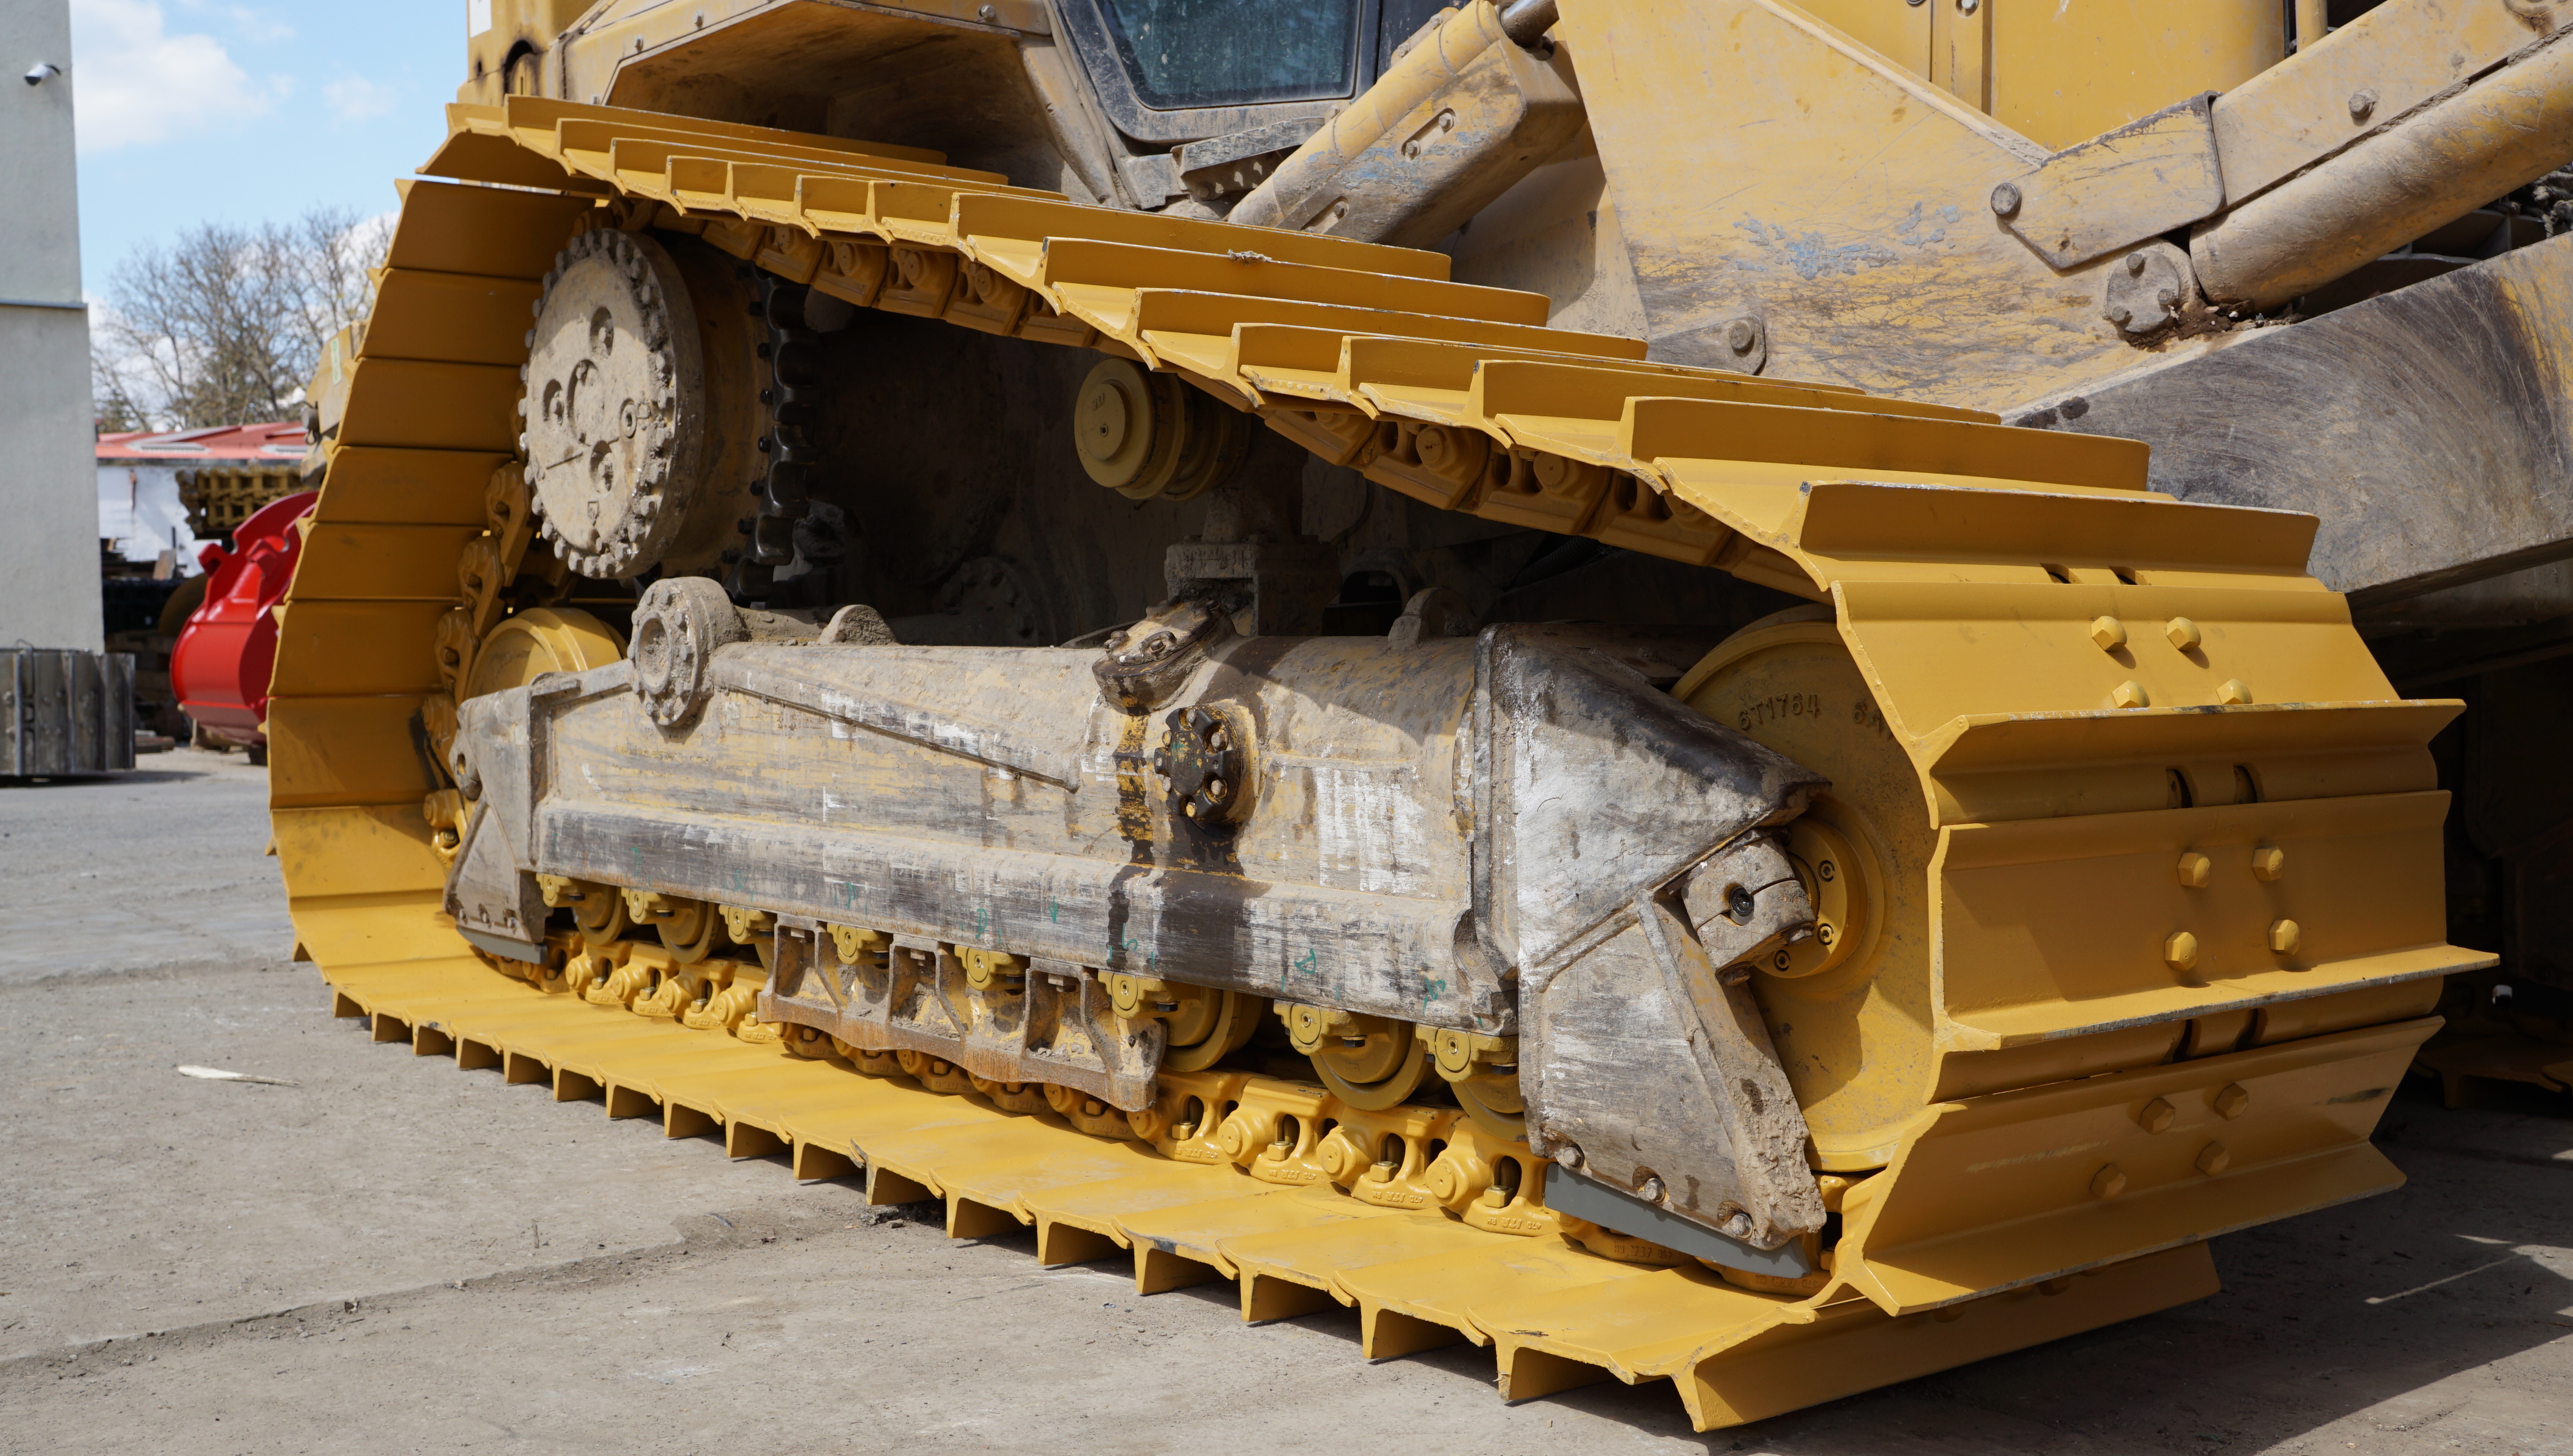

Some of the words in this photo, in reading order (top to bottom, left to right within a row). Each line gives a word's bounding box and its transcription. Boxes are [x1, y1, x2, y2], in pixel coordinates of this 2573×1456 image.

[1739, 692, 1820, 730] 6T1764
[1282, 1170, 1300, 1180] ITR
[1385, 1191, 1405, 1203] ITR
[1501, 1217, 1523, 1229] ITR
[1527, 1221, 1542, 1230] 47D
